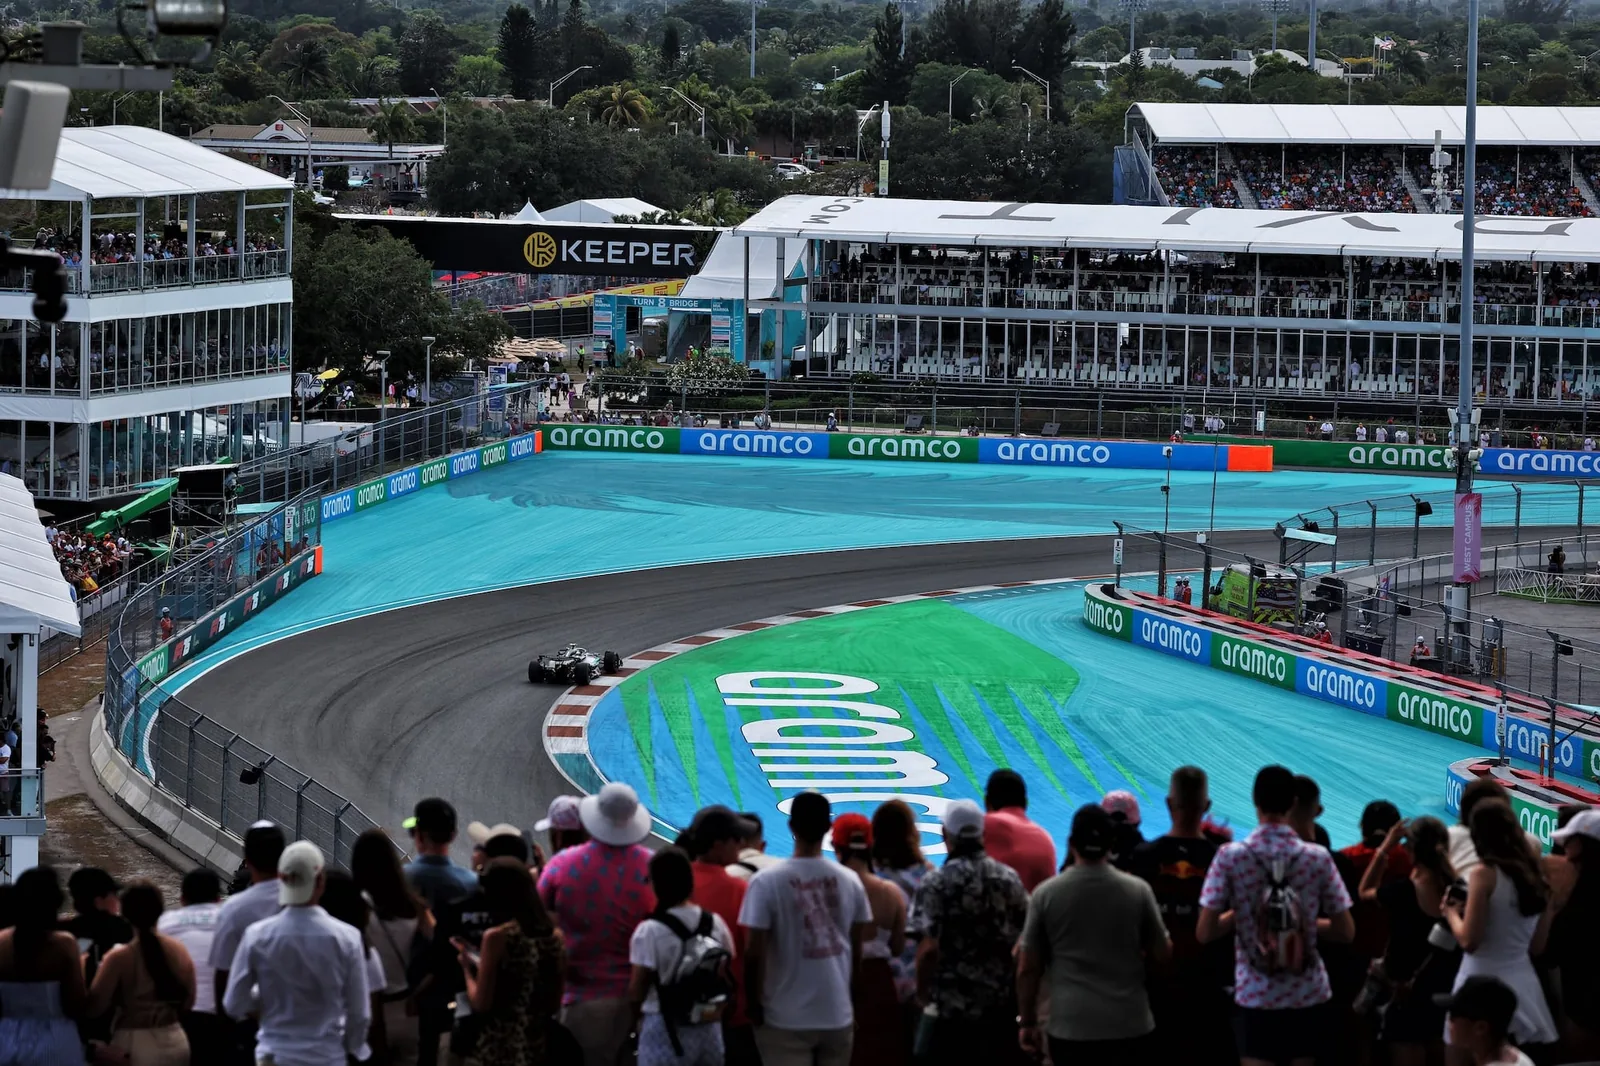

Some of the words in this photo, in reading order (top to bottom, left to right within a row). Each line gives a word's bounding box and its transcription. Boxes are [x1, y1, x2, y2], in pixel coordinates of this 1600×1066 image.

[562, 239, 695, 266] KEEPER
[633, 297, 655, 306] TURN
[658, 298, 666, 308] 8
[669, 299, 699, 308] BRIDGE
[511, 437, 533, 457] aramco
[550, 427, 664, 449] aramco
[699, 431, 813, 455] aramco
[847, 437, 961, 459] aramco
[453, 453, 477, 475] aramco
[483, 445, 506, 466] aramco
[997, 442, 1111, 464] aramco
[390, 471, 416, 495] aramco
[422, 462, 447, 484] aramco
[323, 494, 351, 518] aramco
[357, 482, 384, 506] aramco
[1464, 504, 1473, 544] CAMPUS
[1463, 545, 1472, 573] WEST
[1142, 617, 1201, 657] aramco
[1220, 641, 1286, 682] aramco
[1306, 665, 1375, 708] aramco
[1398, 691, 1472, 735] aramco
